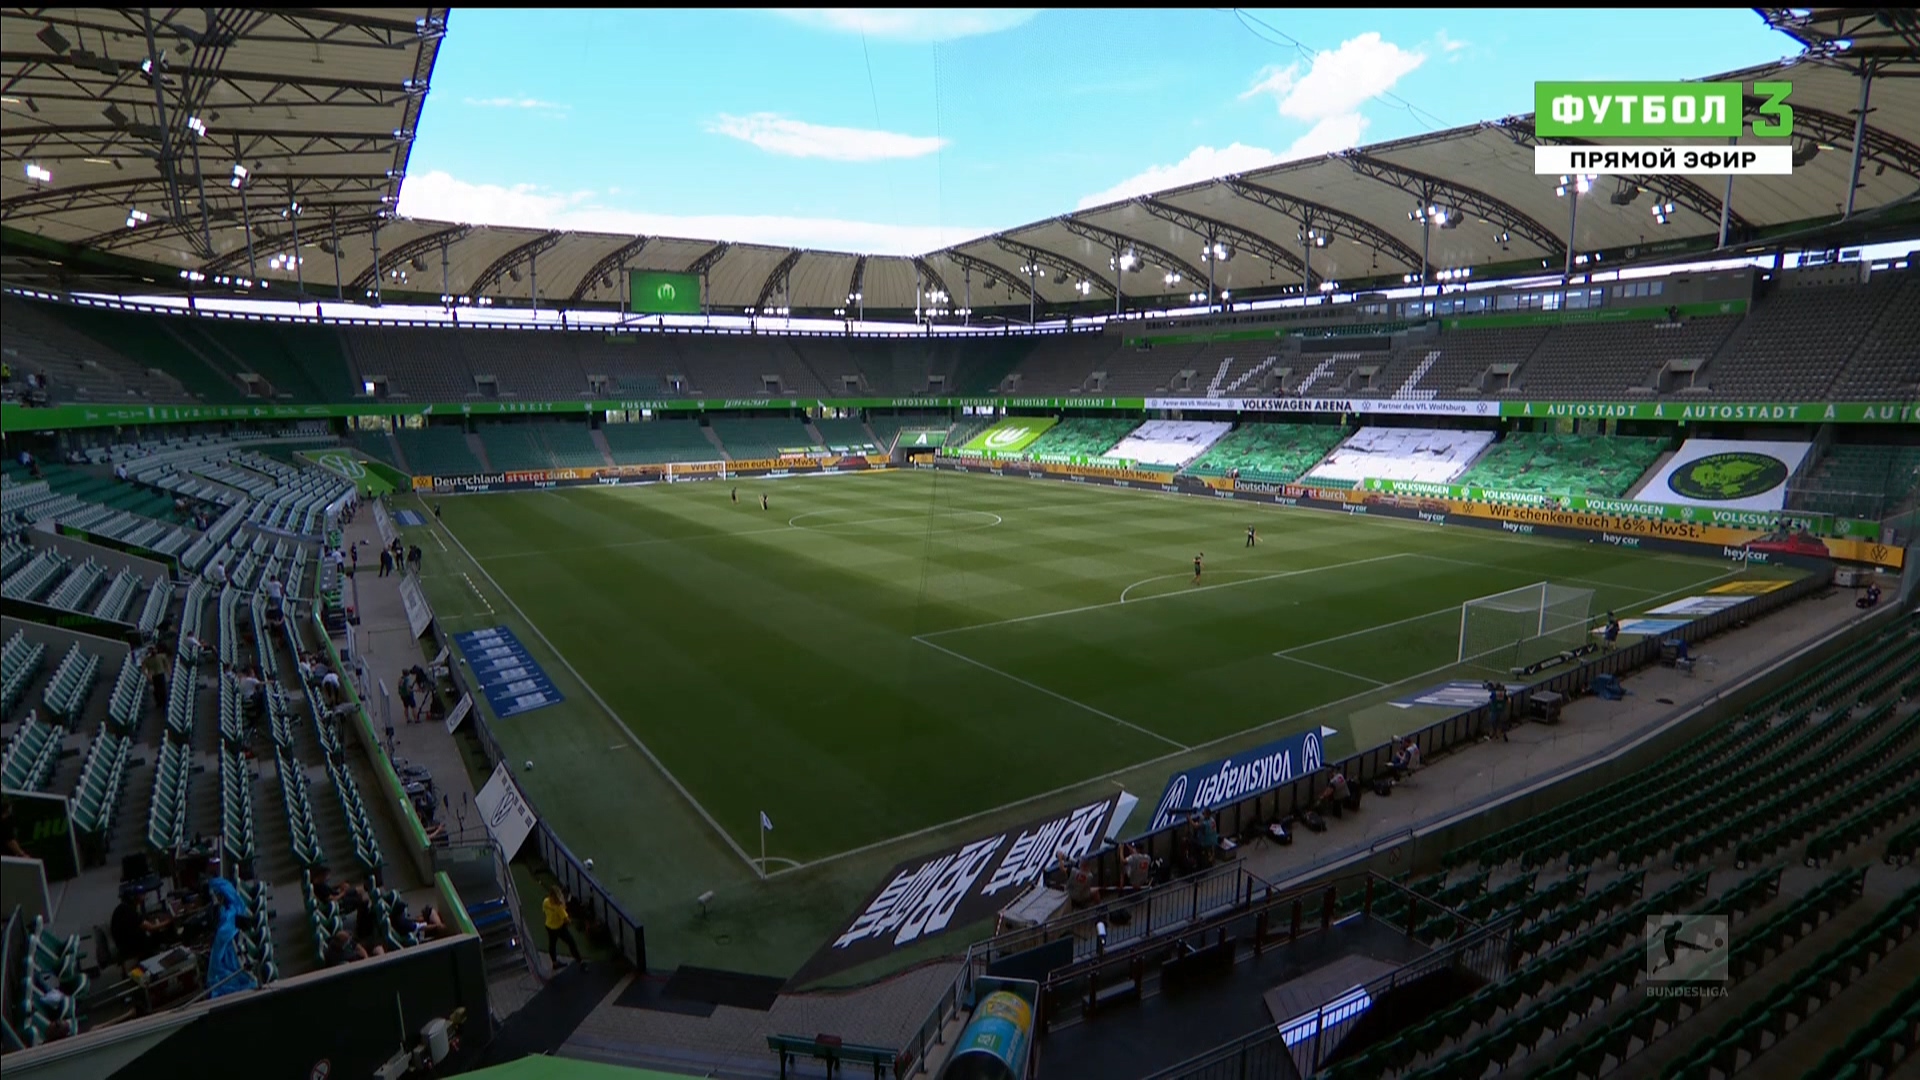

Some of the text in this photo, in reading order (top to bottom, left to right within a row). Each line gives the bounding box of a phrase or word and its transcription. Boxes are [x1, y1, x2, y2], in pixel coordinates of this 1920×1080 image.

[499, 403, 553, 411] ARBEIT
[621, 401, 668, 409] FUSSBALL
[1242, 400, 1352, 411] VOLKSWAGEN ARENA
[1547, 404, 1637, 417] AUTOSTADT
[1683, 405, 1799, 419] AUTOSTADT
[751, 460, 771, 468] euch
[434, 473, 505, 487] Deutschland
[547, 470, 579, 481] durch.
[1320, 488, 1348, 501] durch.
[1392, 482, 1449, 494] VOLKSWAGEN
[1585, 499, 1663, 516] VOLKSWAGEN
[1489, 504, 1512, 517] Wir
[1513, 506, 1573, 525] schenken
[1577, 514, 1609, 528] euch
[1614, 518, 1646, 532] 16%
[1191, 749, 1292, 809] Volkswagen
